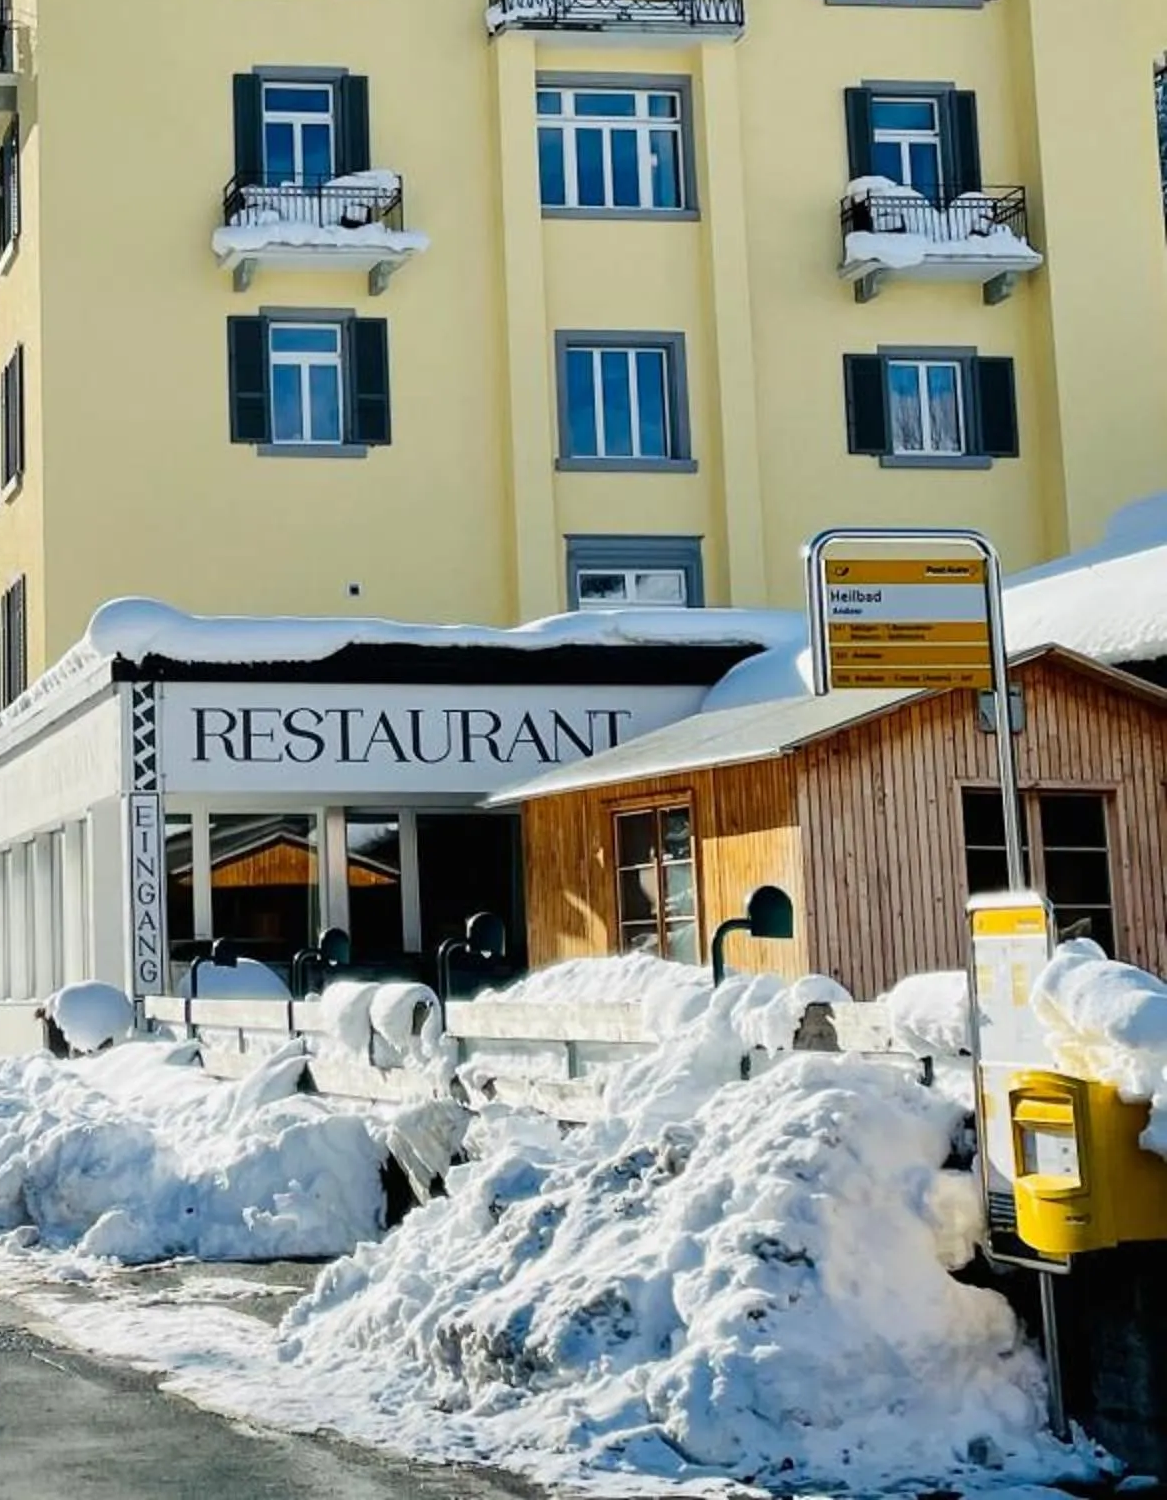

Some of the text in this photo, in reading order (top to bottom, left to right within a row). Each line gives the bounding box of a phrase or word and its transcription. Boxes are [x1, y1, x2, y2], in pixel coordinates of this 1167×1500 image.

[831, 589, 882, 603] Heilbad
[191, 707, 632, 764] RESTAURANT
[134, 806, 158, 983] EINGANG
